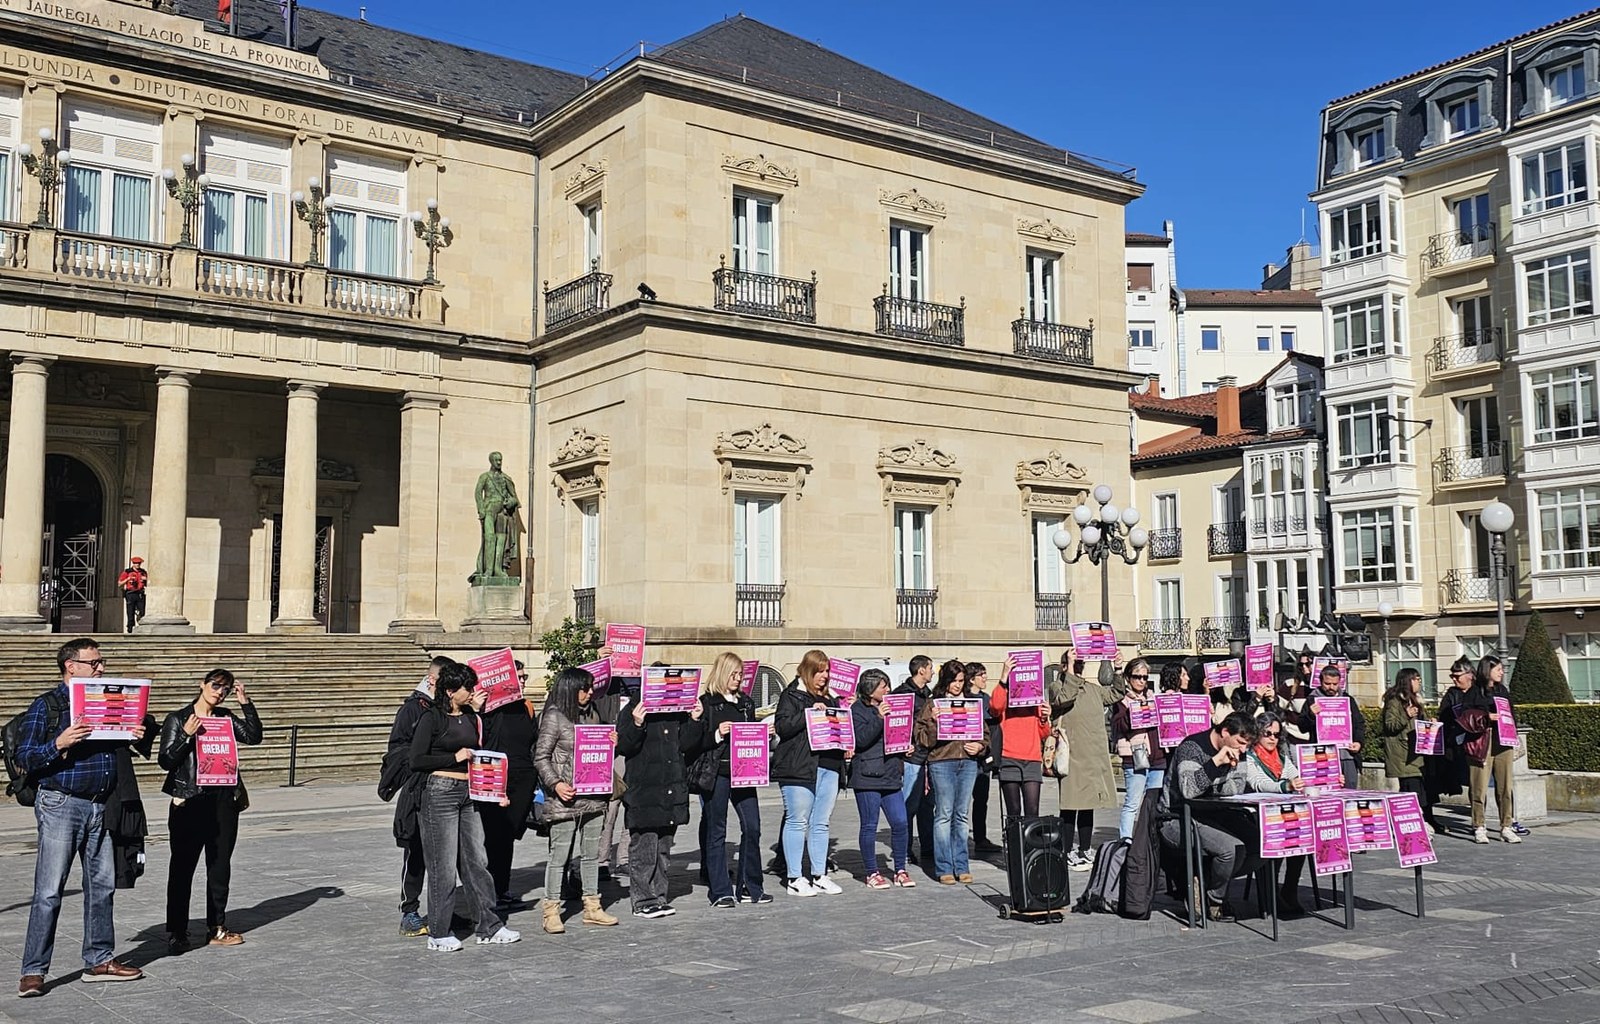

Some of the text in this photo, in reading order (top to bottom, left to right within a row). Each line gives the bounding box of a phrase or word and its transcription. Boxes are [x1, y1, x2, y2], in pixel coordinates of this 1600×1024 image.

[27, 0, 101, 27] JAUREGIA
[119, 20, 183, 44] PALACIO
[193, 36, 212, 50] DE
[220, 42, 239, 57] LA
[248, 49, 320, 75] PROVINCIA
[3, 51, 425, 148] LDUNDIA DIPUTACION FORAL DE ALAVA
